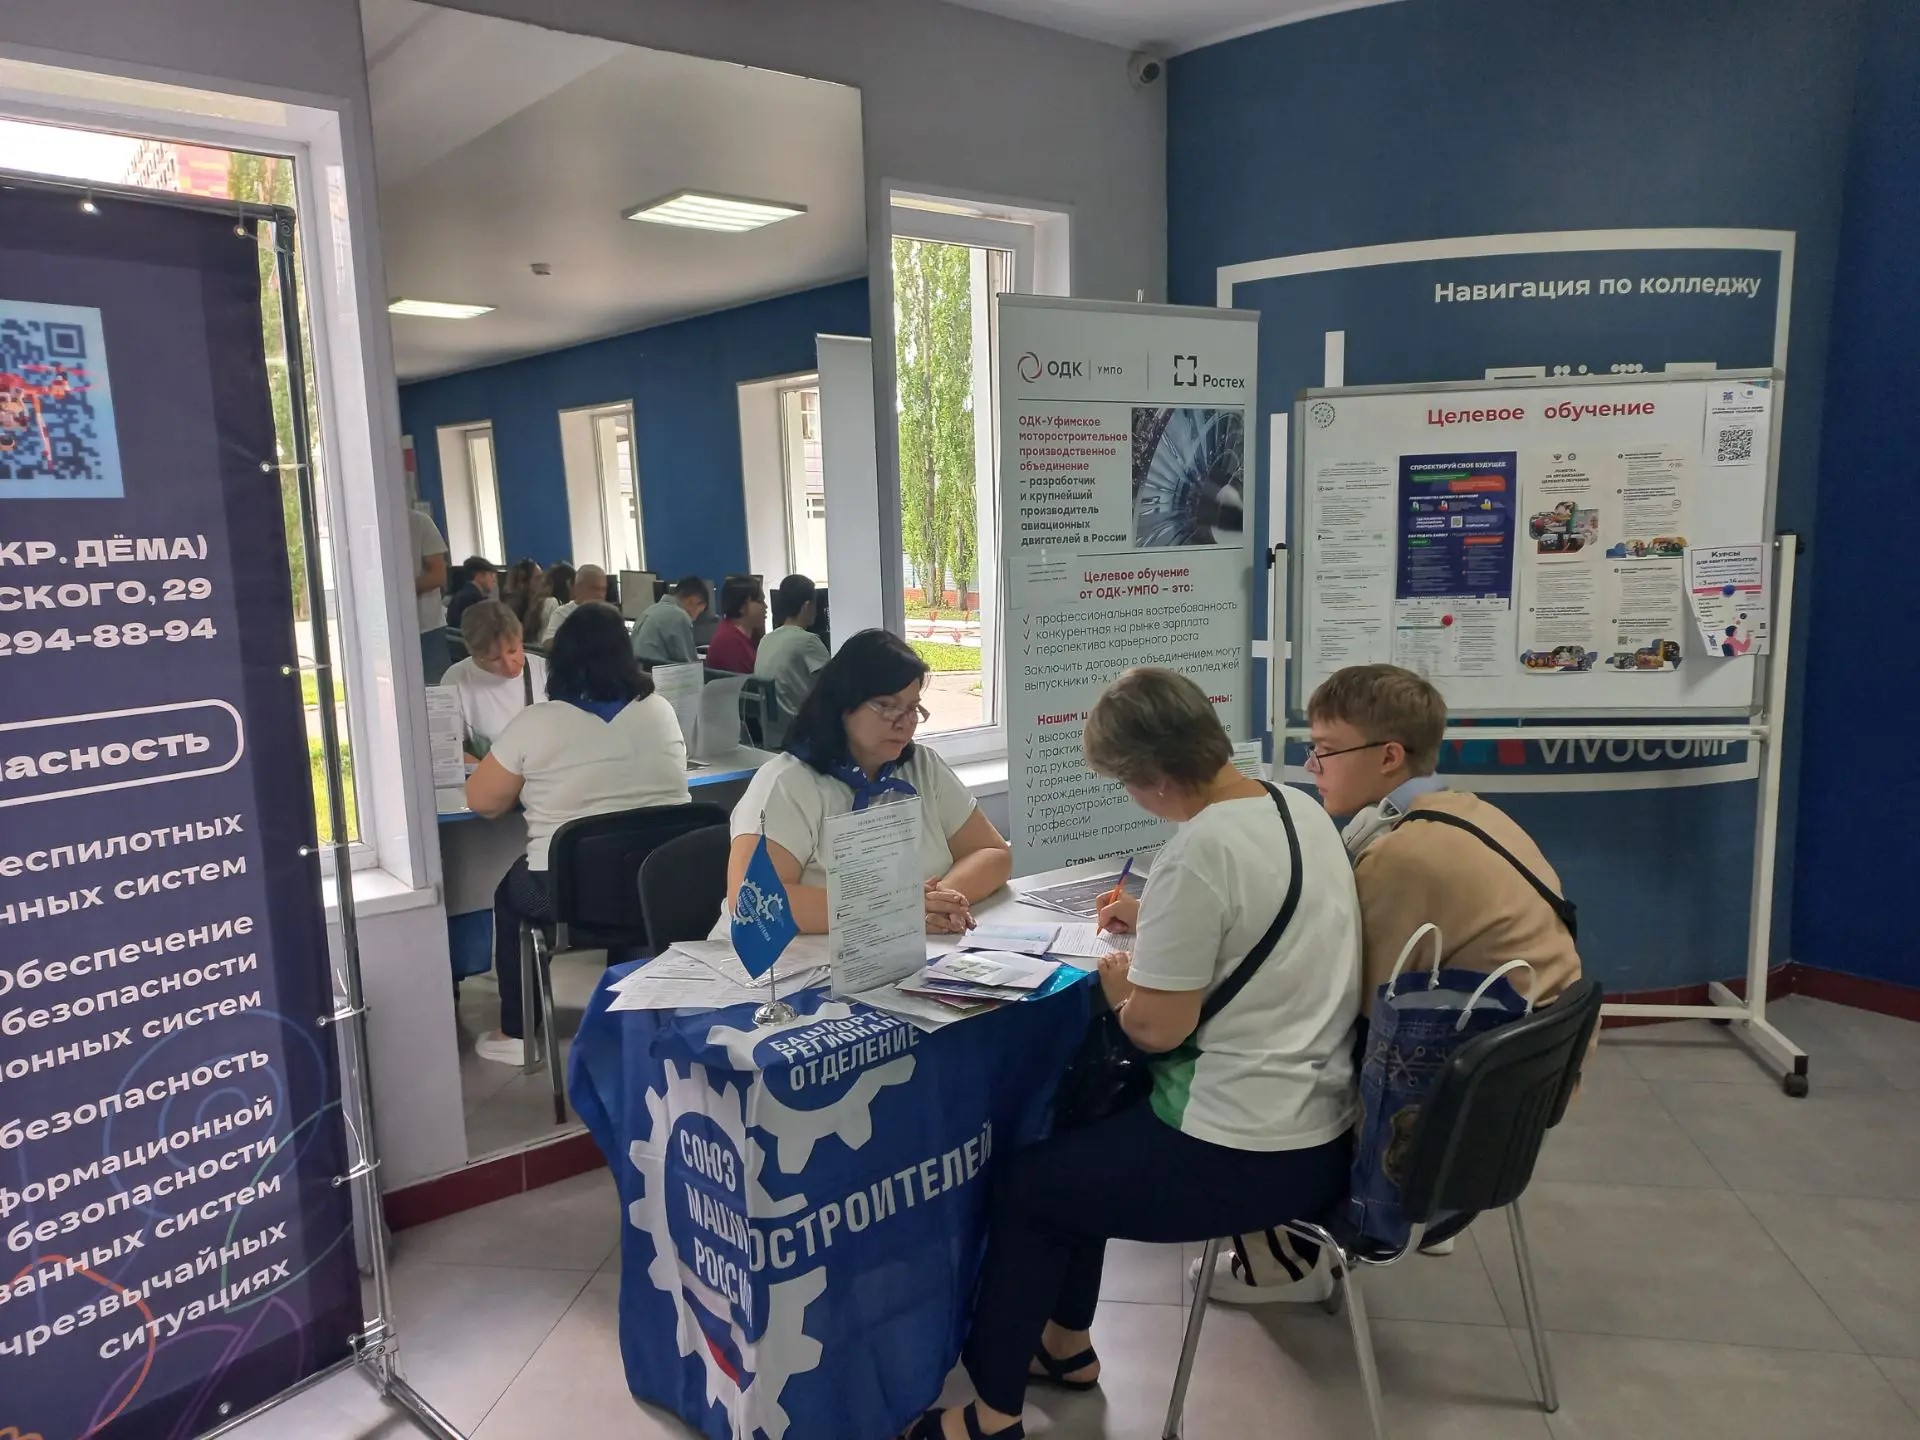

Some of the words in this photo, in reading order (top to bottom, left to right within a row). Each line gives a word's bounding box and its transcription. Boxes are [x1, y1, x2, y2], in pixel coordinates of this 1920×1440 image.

[1435, 279, 1590, 303] Навигация
[1599, 277, 1632, 295] по
[1640, 275, 1761, 298] колледжу
[1047, 360, 1083, 378] ОДК
[1097, 366, 1123, 375] УМПО
[1202, 374, 1245, 389] Ростех
[1019, 415, 1101, 429] ОДК-Уфимское
[1427, 407, 1525, 427] Целевое
[1544, 401, 1656, 421] обучение
[1019, 431, 1128, 443] моторостроительное
[1019, 445, 1117, 458] производственное
[1019, 460, 1090, 472] объединение
[1410, 462, 1456, 471] СПРОЕКТИРУЙ
[1029, 475, 1096, 488] разработчик
[1020, 492, 1027, 500] и
[1029, 489, 1093, 503] крупнейший
[1020, 505, 1099, 517] производитель
[1021, 519, 1090, 532] авиационных
[1021, 533, 1080, 547] двигателей
[1083, 535, 1089, 543] в
[1091, 532, 1127, 543] России
[74, 534, 208, 568] ДЁМА)
[1084, 571, 1133, 584] Целевое
[1137, 567, 1189, 581] обучение
[1079, 590, 1093, 599] от
[1096, 584, 1159, 599] ОДК-УМПО
[1172, 583, 1193, 593] это:
[1035, 609, 1143, 627] профессиональная
[1146, 601, 1237, 619] востребованность
[1036, 626, 1111, 642] конкурентная
[1114, 625, 1127, 633] на
[1129, 621, 1160, 634] рынке
[1162, 617, 1209, 632] зарплата
[1036, 641, 1106, 657] перспектива
[1108, 634, 1168, 650] карьерного
[1170, 632, 1199, 645] роста
[1024, 662, 1083, 676] Заключить
[1085, 657, 1129, 672] договор
[1131, 657, 1138, 665] с
[1140, 649, 1213, 664] объединением
[1215, 646, 1241, 658] могут
[1024, 676, 1089, 691] выпускники
[1185, 659, 1239, 674] колледжей
[1037, 713, 1078, 725] Нашим
[1038, 729, 1084, 743] высокая
[0, 733, 210, 783] асность
[1039, 744, 1084, 759] практик
[1026, 764, 1047, 775] под
[1050, 758, 1087, 772] руково
[1039, 773, 1082, 788] горячее
[1027, 784, 1100, 805] прохождения
[1041, 795, 1129, 817] трудоустройство
[1027, 815, 1091, 834] профессии
[1041, 829, 1099, 846] жилищные
[1101, 818, 1158, 836] программы
[0, 814, 244, 877] еспилотных
[114, 856, 247, 900] систем
[1, 953, 257, 1036] безопасности
[0, 1027, 133, 1082] онных
[142, 990, 261, 1038] систем
[781, 1017, 904, 1064] РЕГИОНАЛ
[790, 1024, 919, 1091] ОТДЕЛЕНИЕ
[0, 1050, 269, 1149] безопасность
[680, 1129, 736, 1192] СОЮЗ
[7, 1136, 277, 1252] безопасности
[154, 1174, 281, 1239] систем
[0, 1220, 287, 1356] чрезвычайных
[99, 1259, 290, 1359] ситуациях
